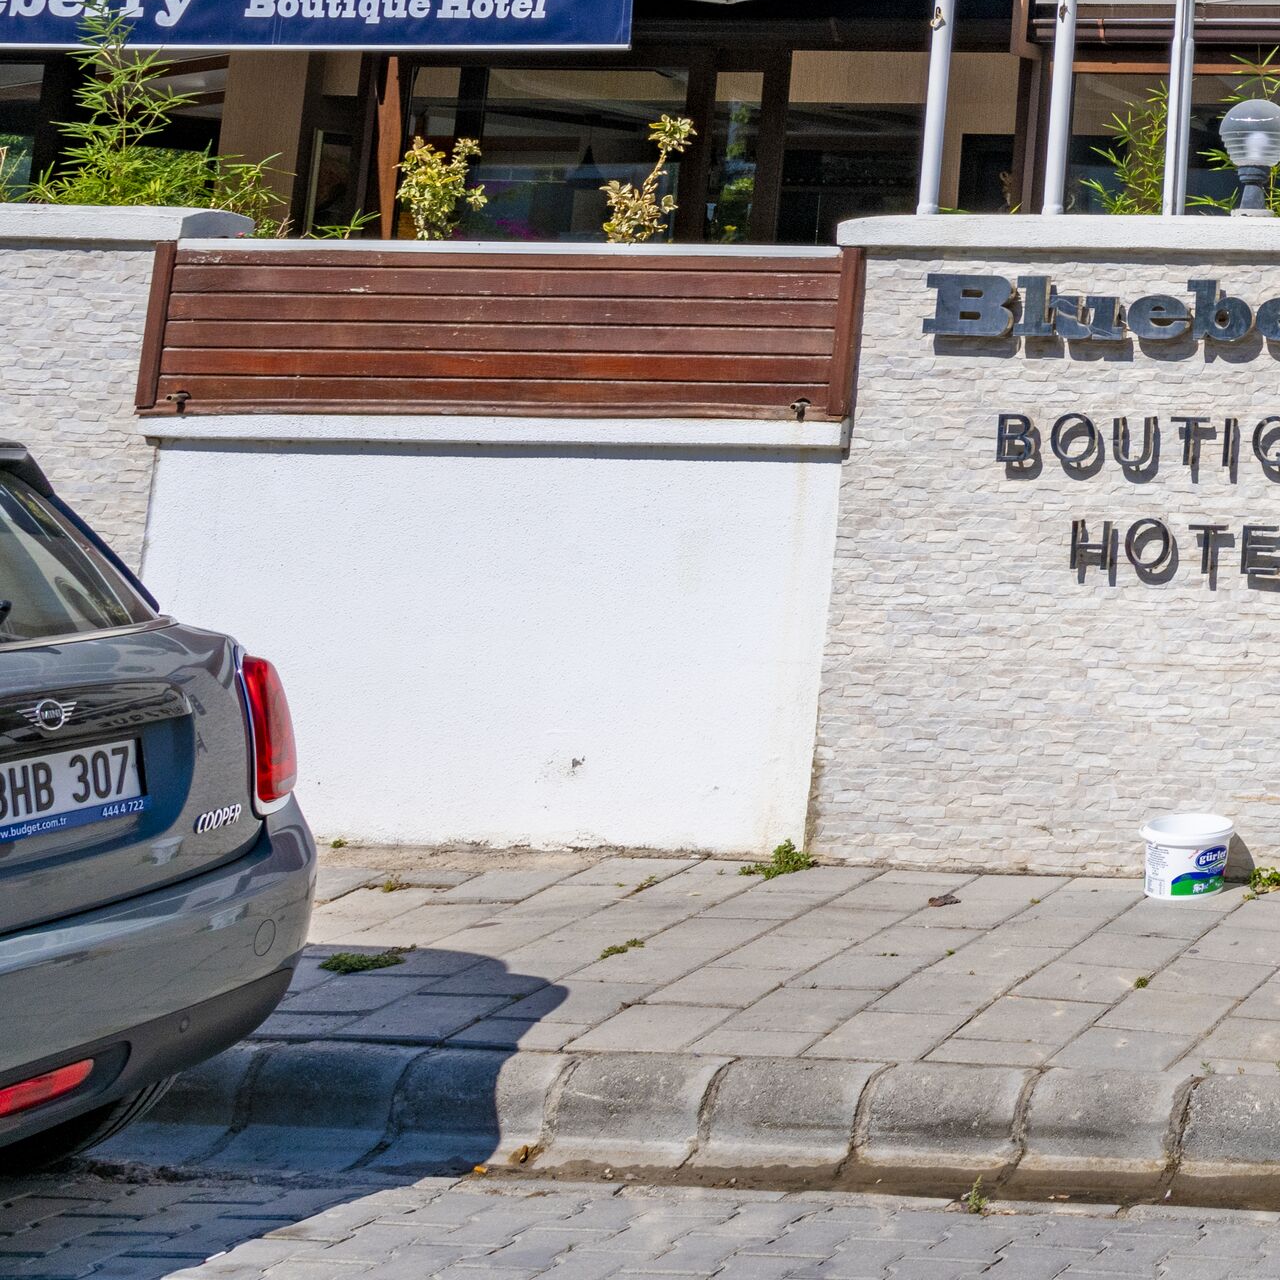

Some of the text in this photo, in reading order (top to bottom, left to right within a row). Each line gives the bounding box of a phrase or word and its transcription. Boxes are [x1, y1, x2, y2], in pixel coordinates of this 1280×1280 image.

[69, 746, 129, 804] 307
[102, 804, 119, 817] 444
[129, 799, 144, 812] 722
[195, 803, 242, 834] COOPER
